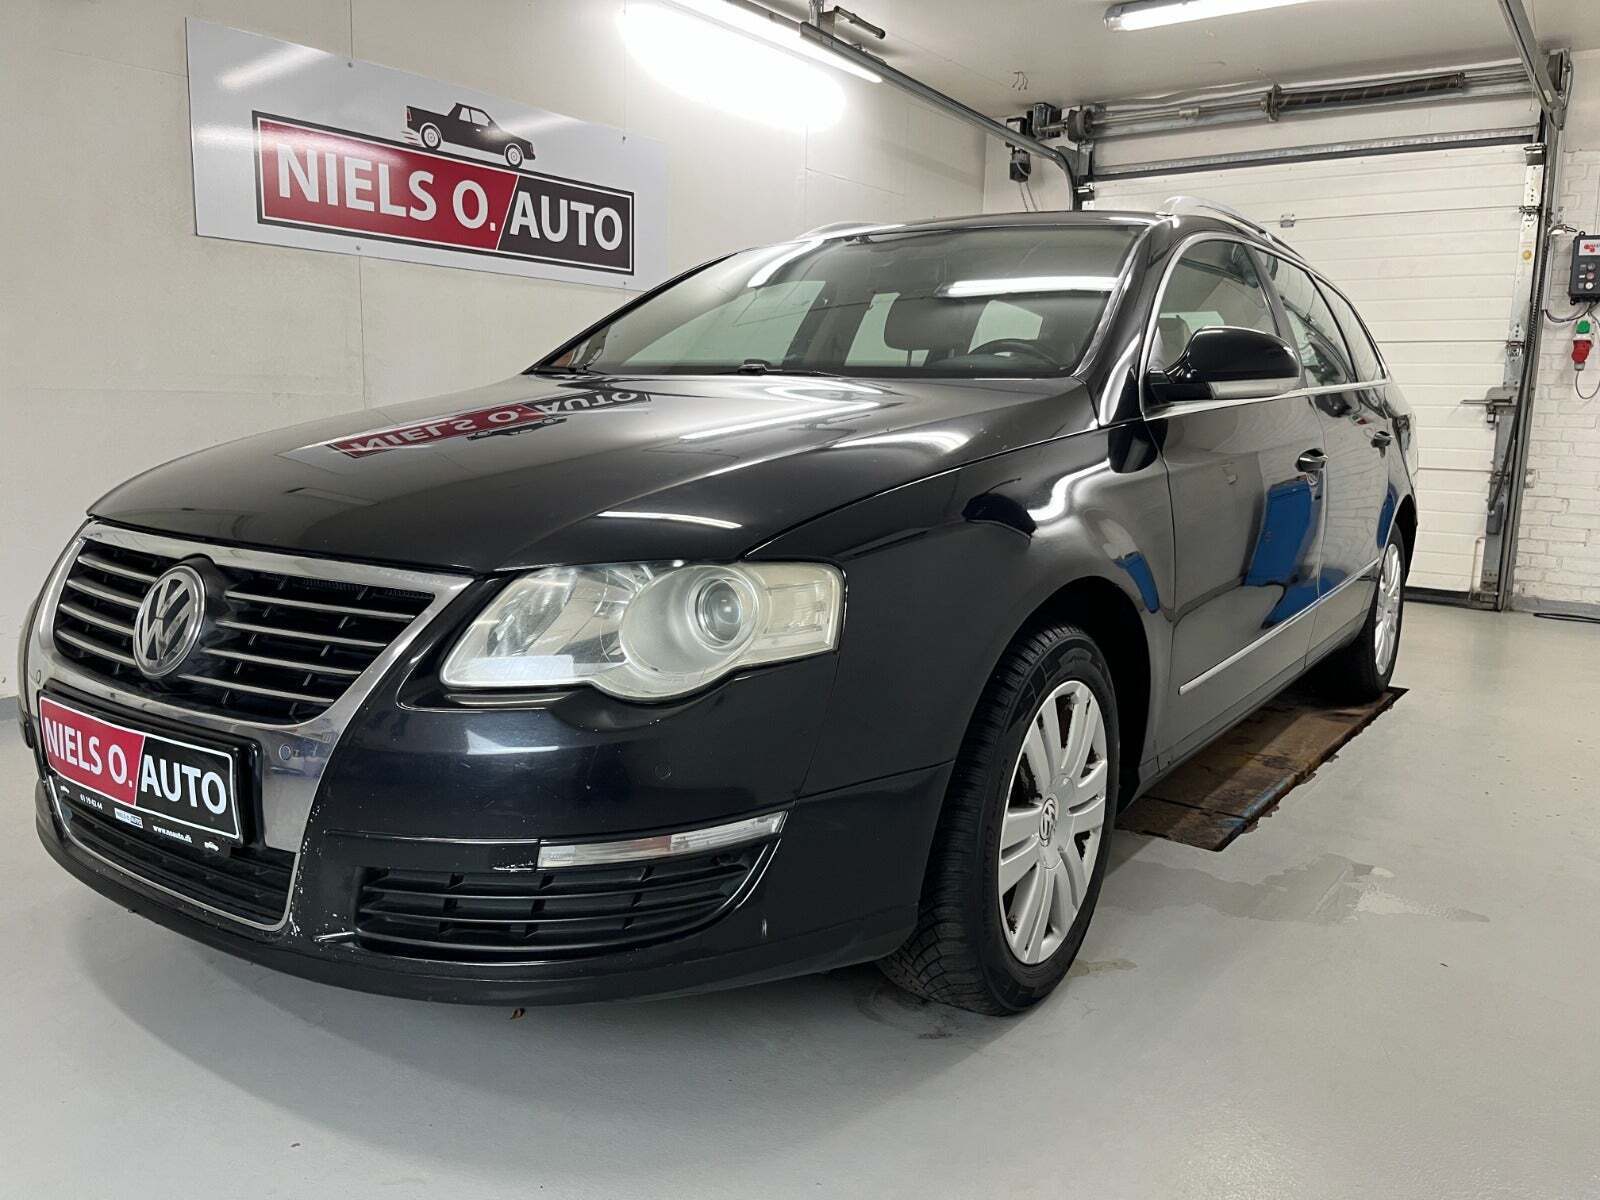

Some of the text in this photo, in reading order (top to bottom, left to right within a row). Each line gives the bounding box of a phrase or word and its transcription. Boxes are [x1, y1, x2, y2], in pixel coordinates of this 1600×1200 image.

[276, 143, 623, 250] NIELS O. AUTO
[44, 717, 227, 815] NIELS O. AUTO
